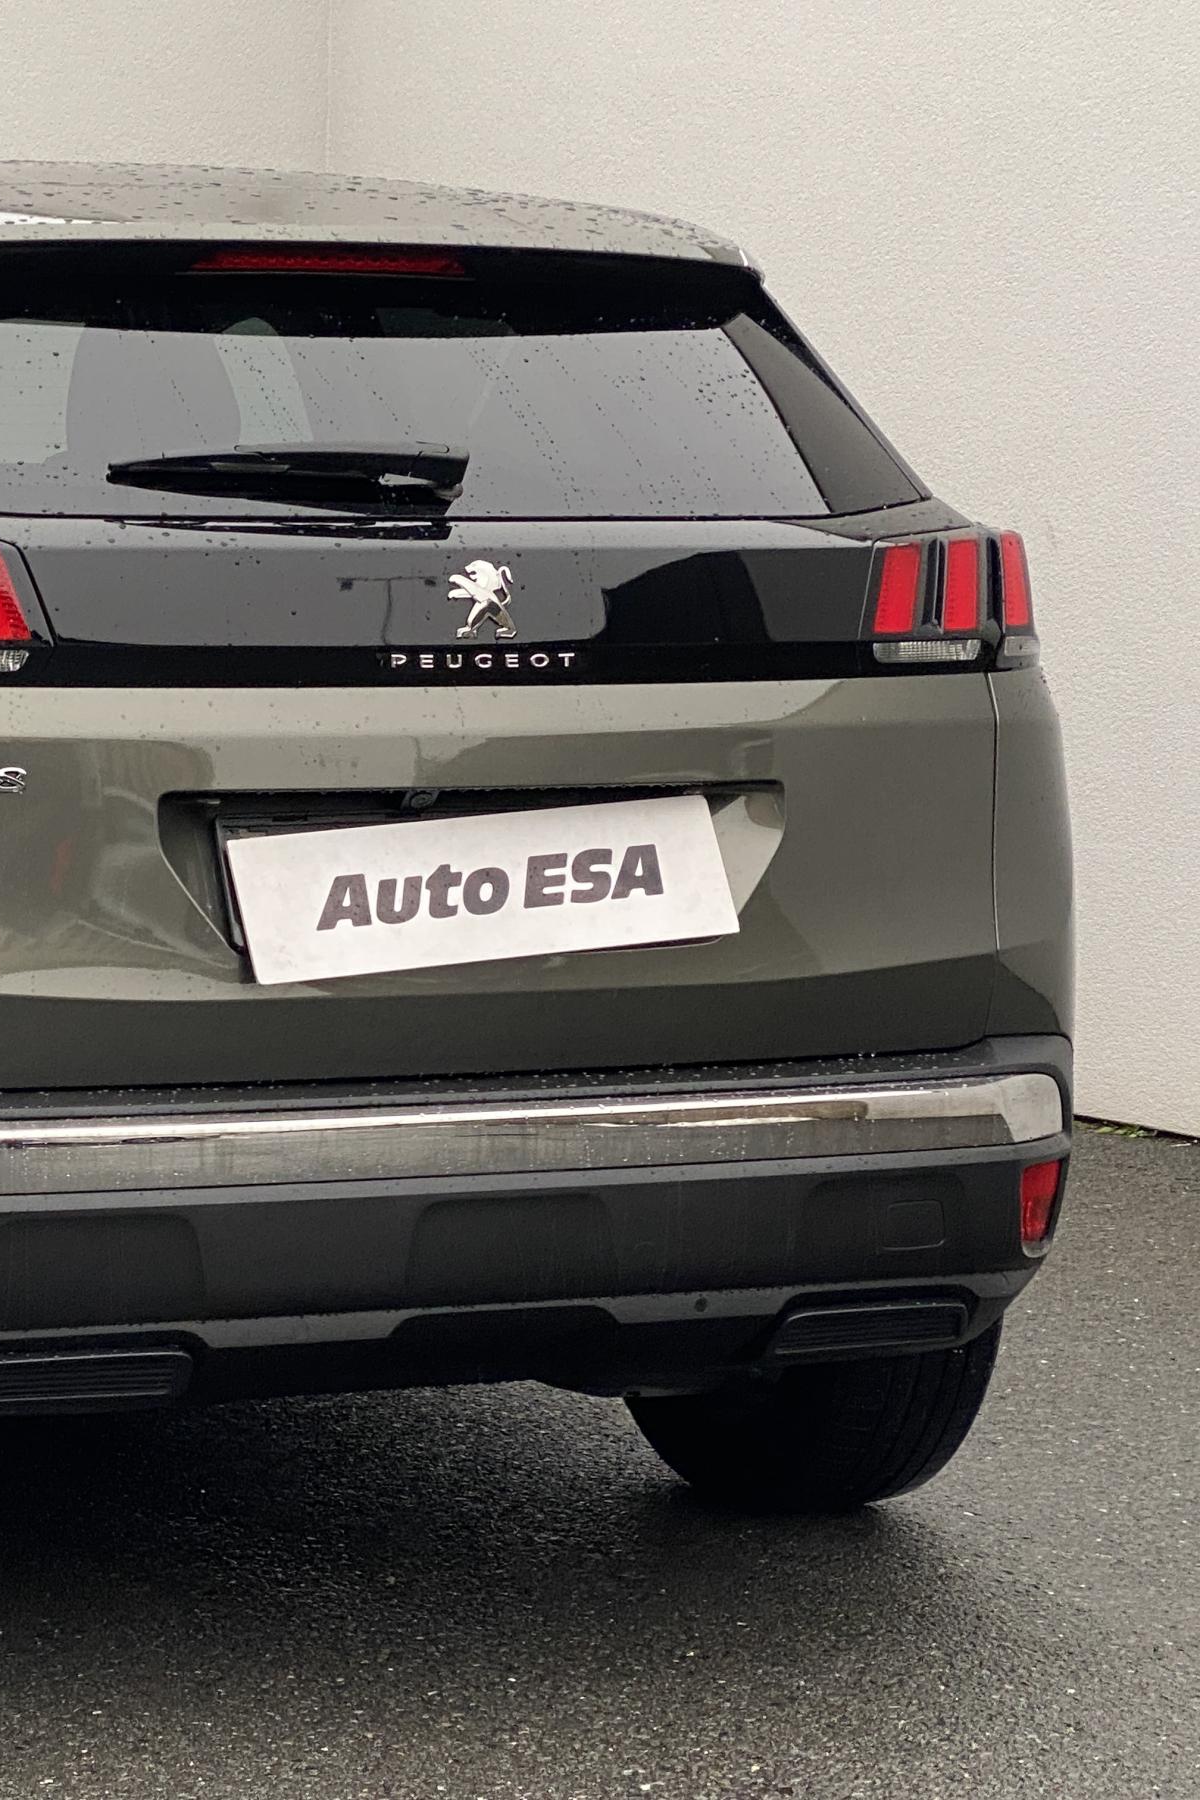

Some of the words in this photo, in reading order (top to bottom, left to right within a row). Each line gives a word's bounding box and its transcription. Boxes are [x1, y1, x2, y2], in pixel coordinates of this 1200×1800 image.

[389, 652, 575, 669] PEUGEOT
[316, 863, 510, 931] Auto
[524, 843, 664, 909] ESA
